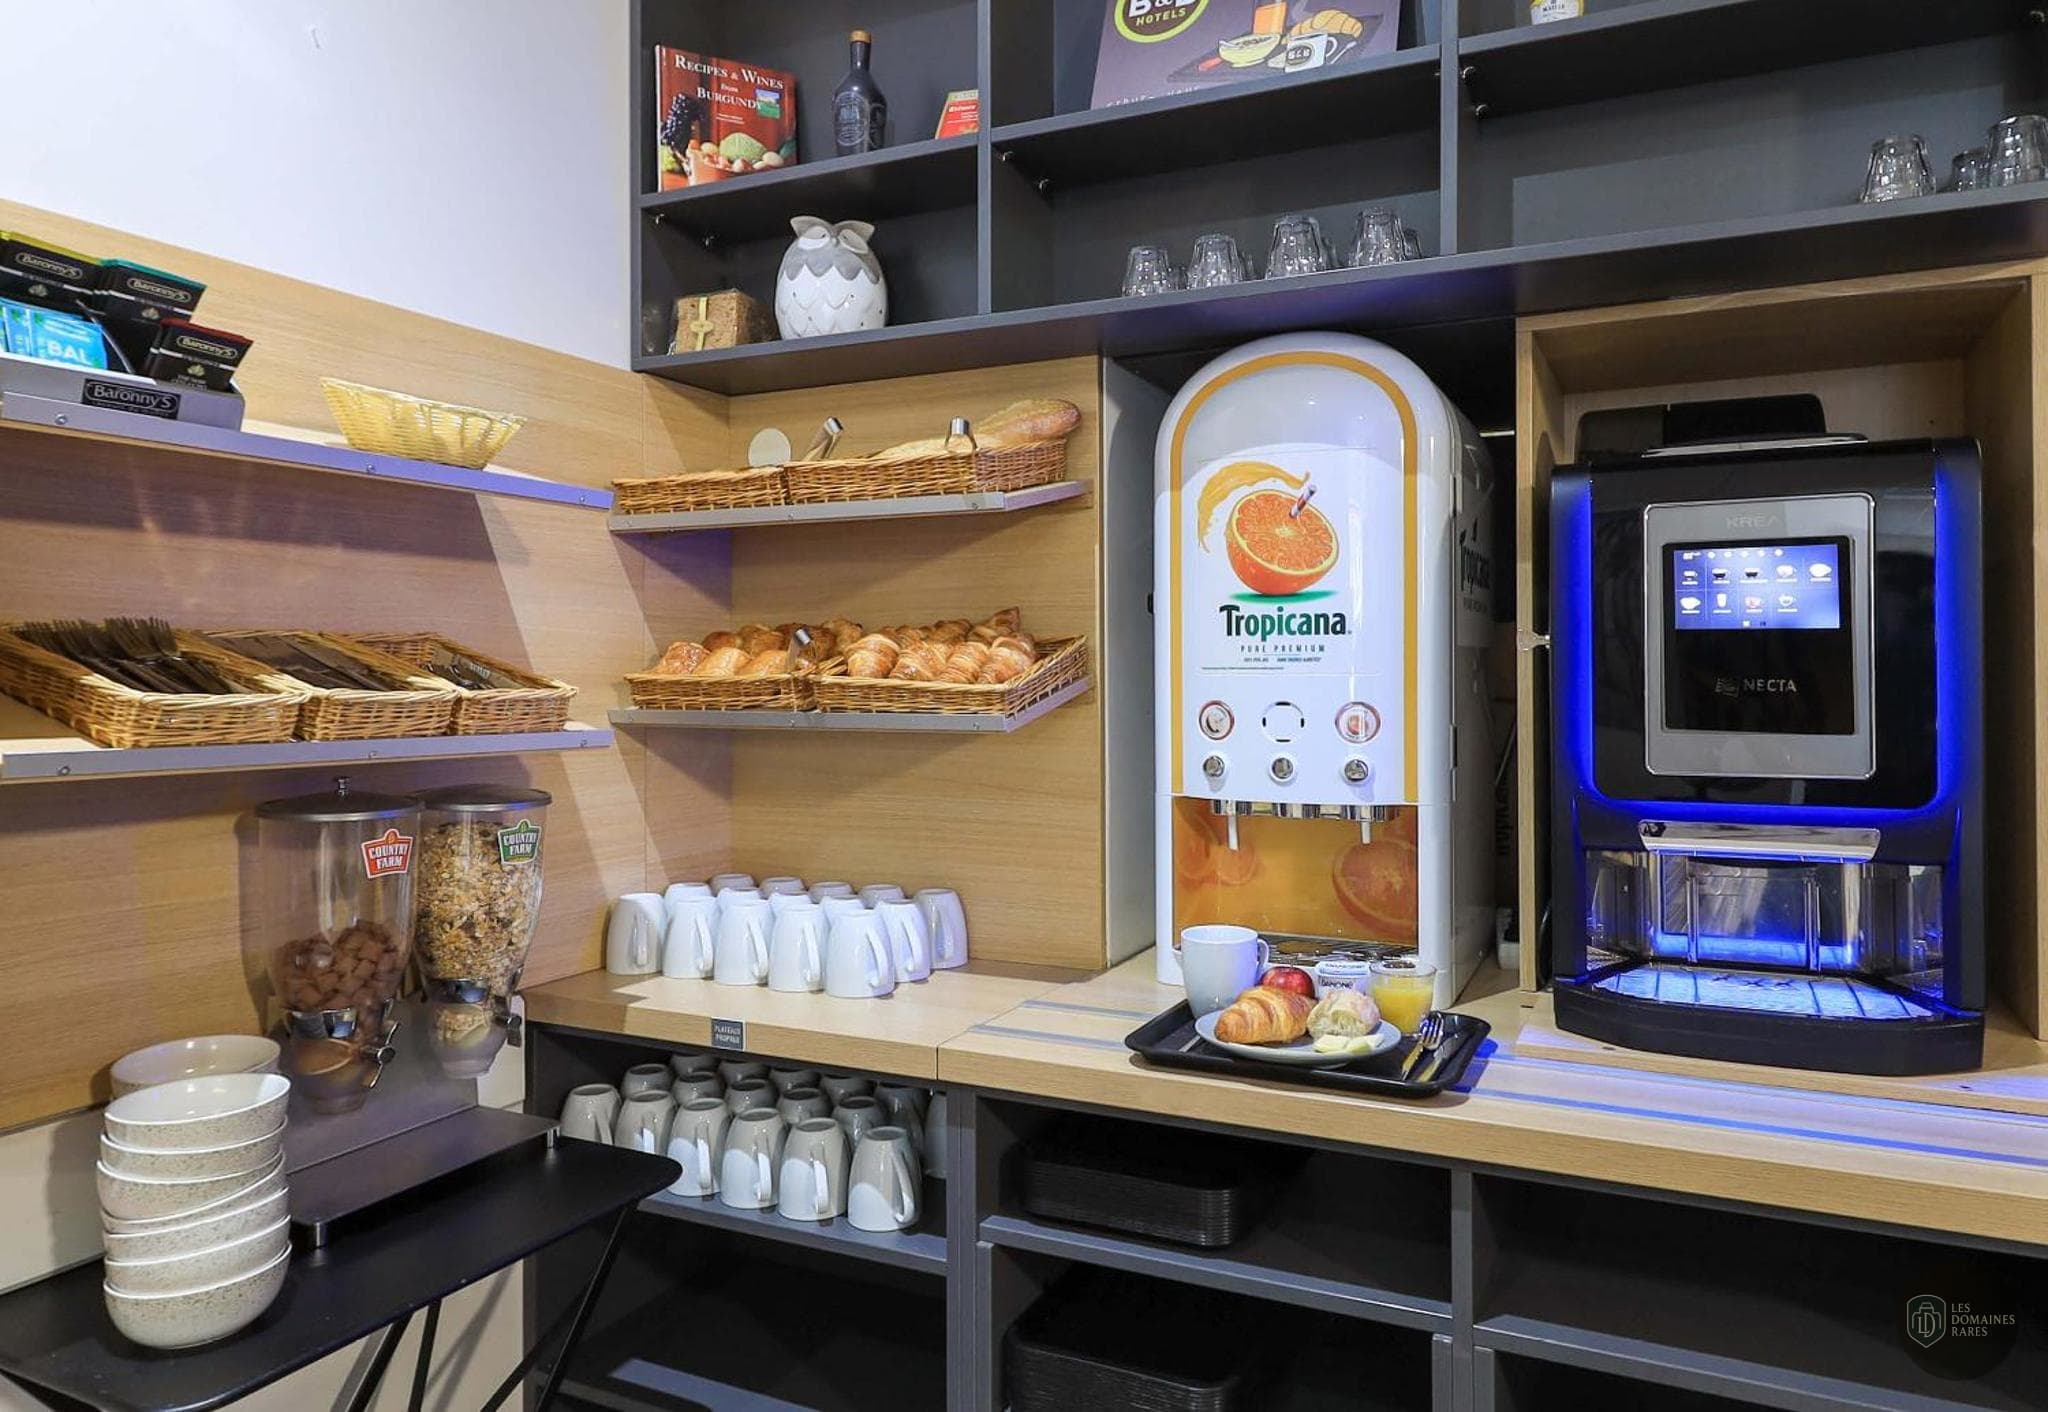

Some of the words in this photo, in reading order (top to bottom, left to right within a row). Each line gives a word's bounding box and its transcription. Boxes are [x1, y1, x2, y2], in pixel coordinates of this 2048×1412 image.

[1136, 8, 1187, 26] HOTELS
[675, 53, 728, 78] RECIPES
[730, 71, 739, 81] &
[741, 68, 784, 90] WINES
[1726, 514, 1781, 529] KREA
[1219, 604, 1347, 642] Tropicana
[1240, 644, 1266, 653] PURE
[1274, 644, 1325, 653] PREMIUM
[1743, 679, 1797, 692] NECTA
[377, 855, 403, 870] FARM
